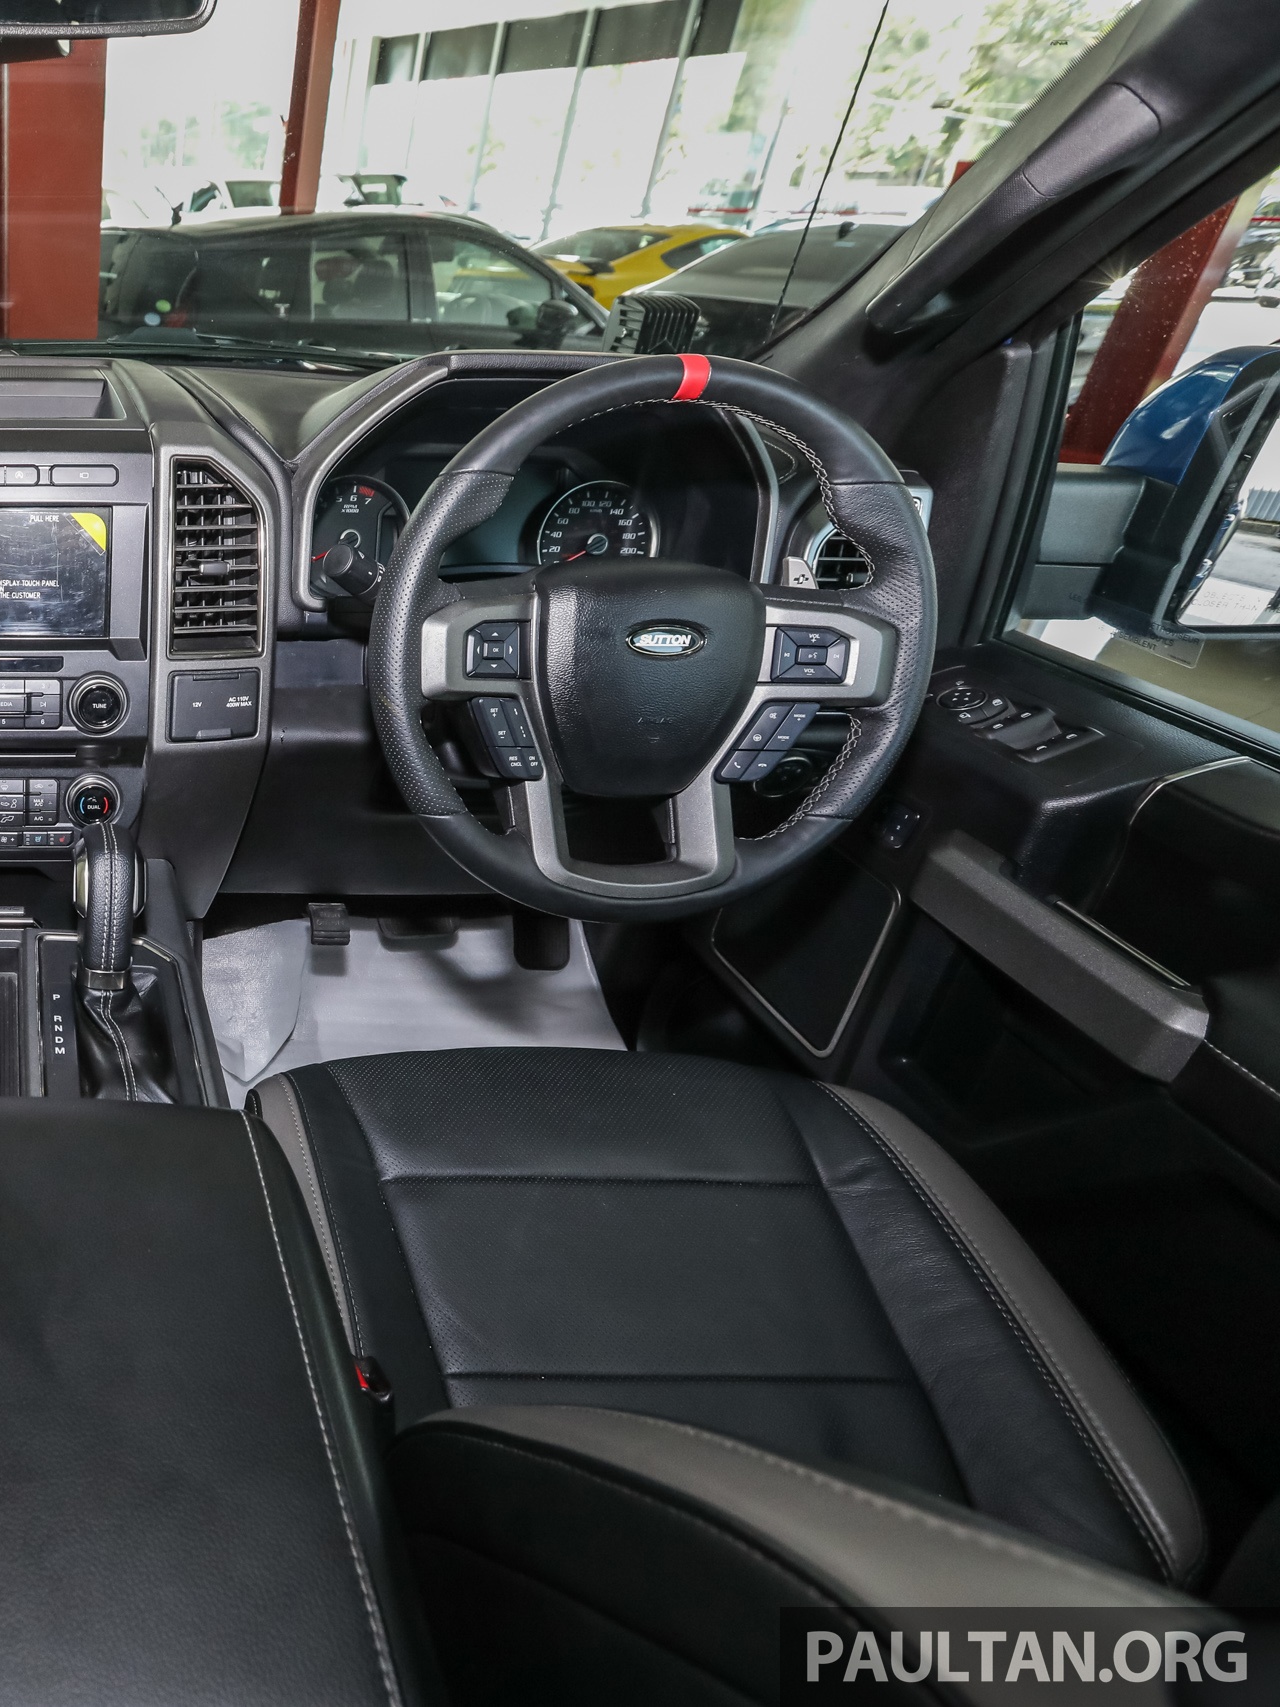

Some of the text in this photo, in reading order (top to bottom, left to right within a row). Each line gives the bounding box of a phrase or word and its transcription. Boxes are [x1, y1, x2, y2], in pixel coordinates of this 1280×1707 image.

[349, 494, 358, 502] 6
[365, 497, 372, 505] 7
[29, 514, 60, 523] PULL HERE
[549, 545, 561, 553] 20
[639, 634, 692, 645] SUTTON
